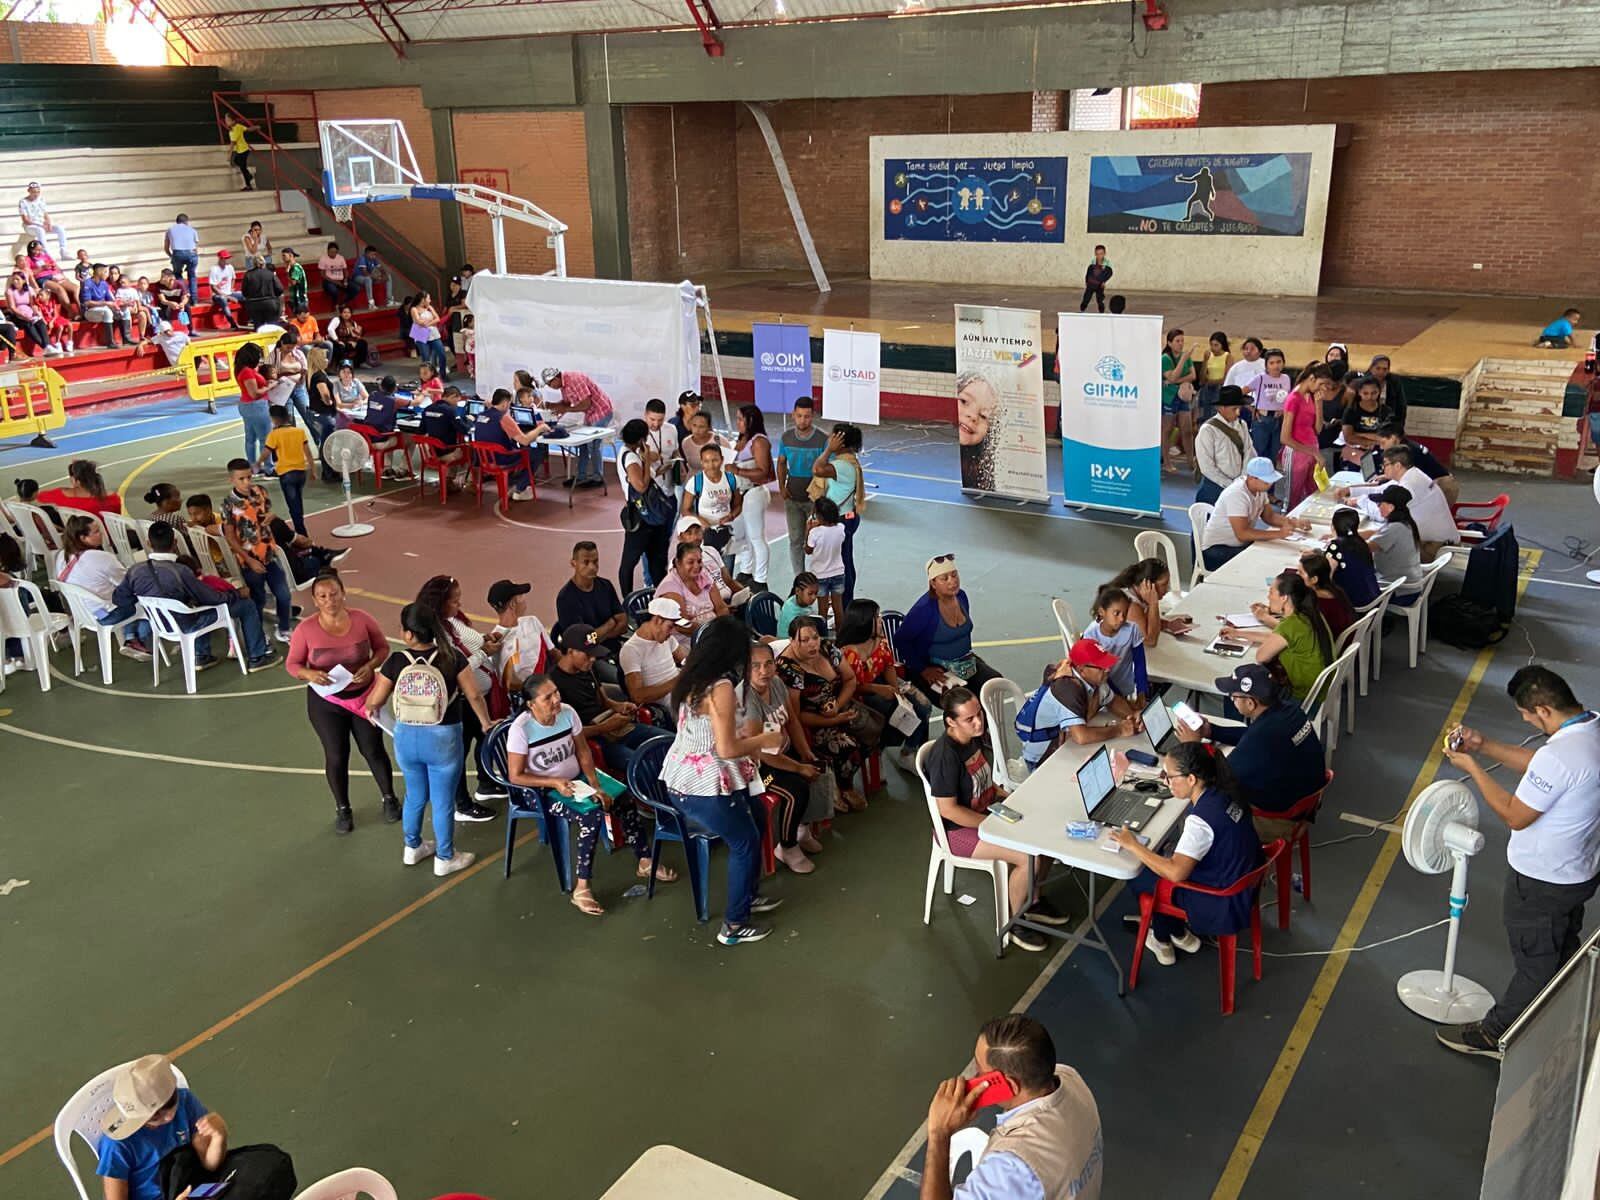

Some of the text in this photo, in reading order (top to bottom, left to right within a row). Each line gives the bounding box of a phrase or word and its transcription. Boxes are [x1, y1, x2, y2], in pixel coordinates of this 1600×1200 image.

[1162, 222, 1171, 231] TE
[982, 335, 999, 344] HAY
[1001, 337, 1033, 347] TIEMPO
[776, 353, 804, 367] OIM
[843, 369, 876, 380] USAID
[1083, 382, 1139, 399] GIFMM
